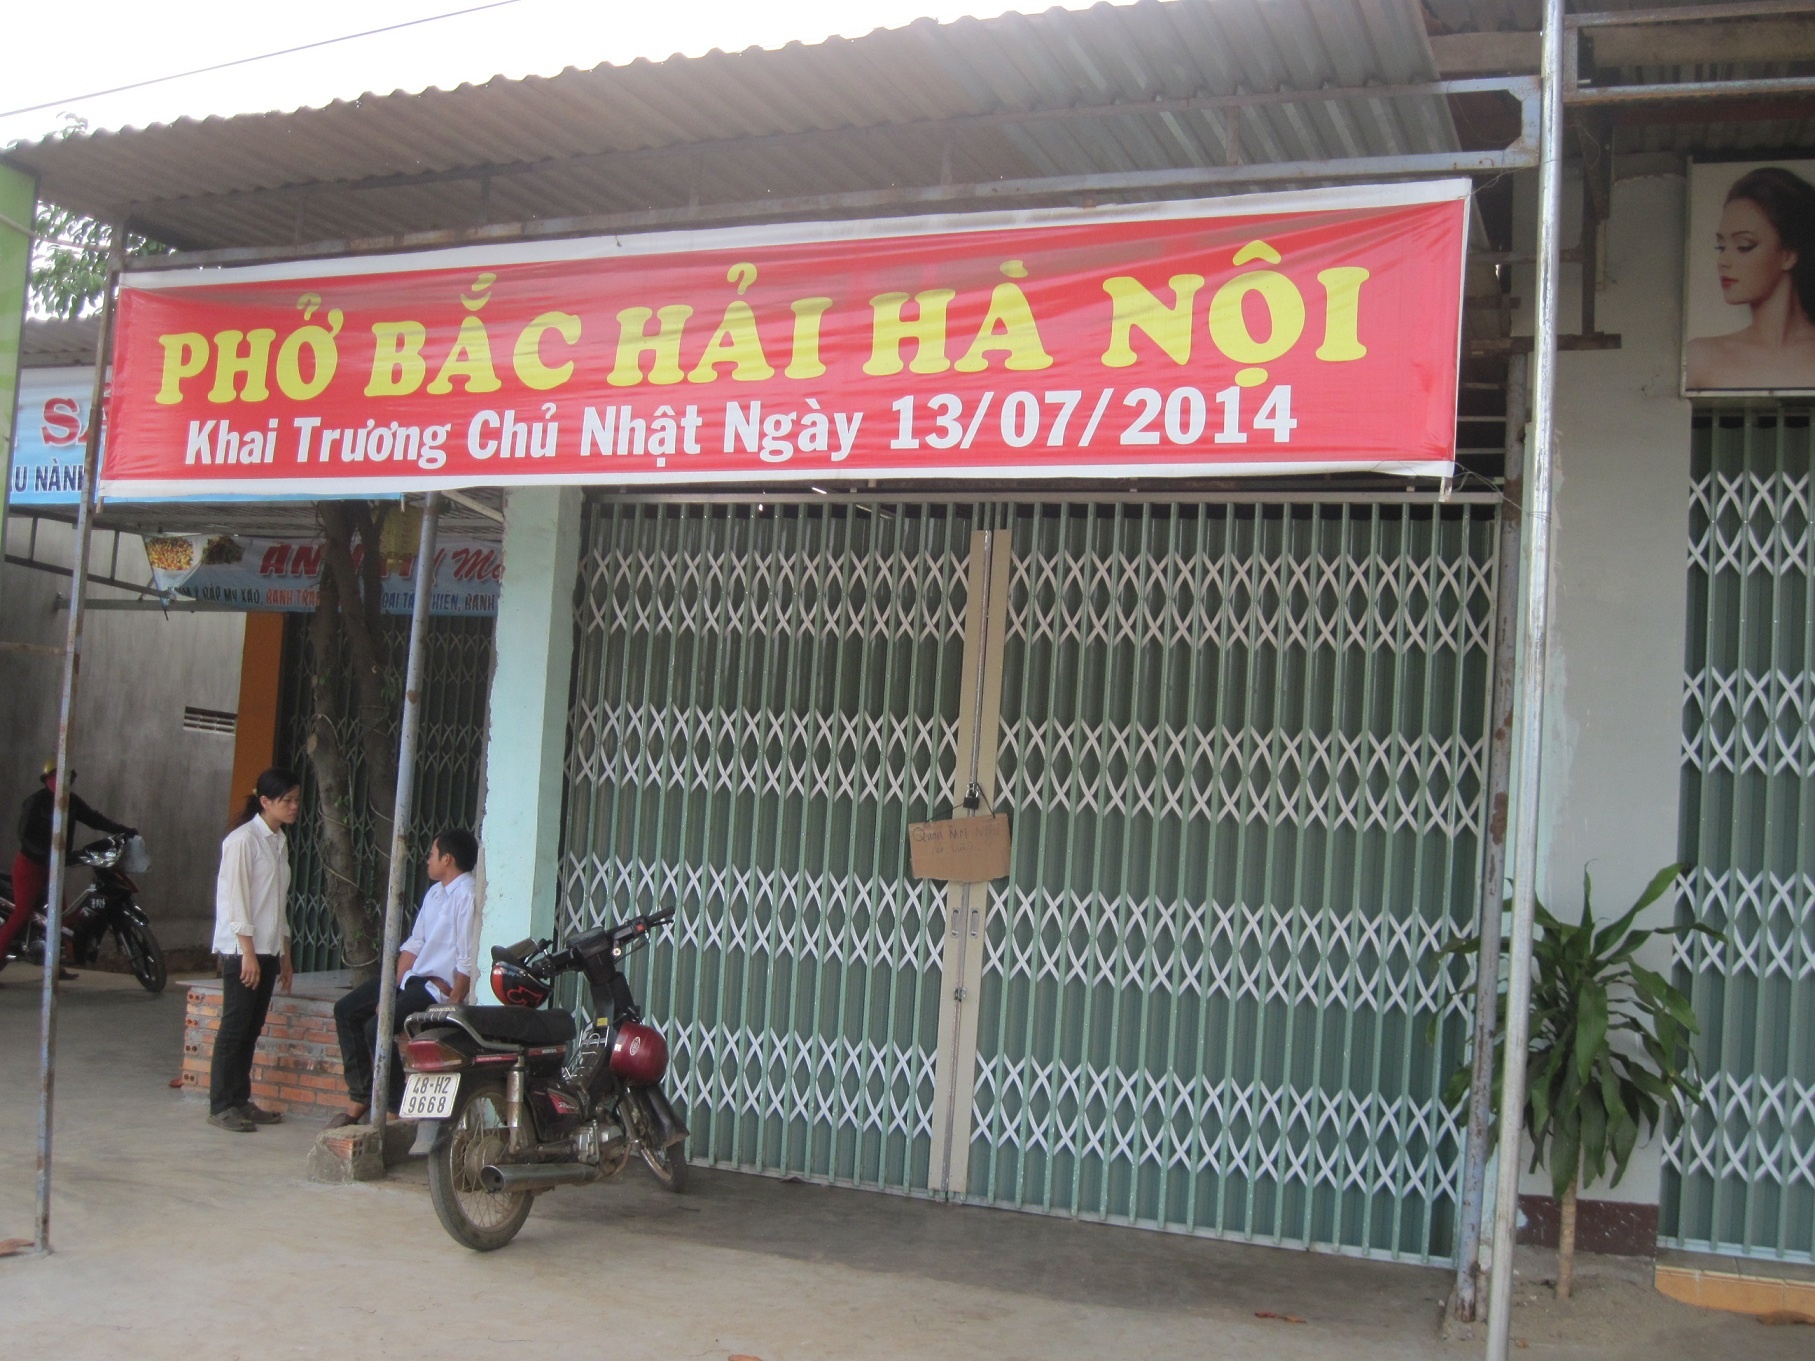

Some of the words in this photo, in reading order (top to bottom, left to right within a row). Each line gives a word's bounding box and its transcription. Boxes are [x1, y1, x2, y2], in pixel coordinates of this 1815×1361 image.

[155, 292, 344, 405] PHỞ
[364, 273, 582, 397] BẮC
[606, 262, 833, 387] HẢI
[862, 260, 1054, 377] HÀ
[1101, 239, 1370, 387] NỘI
[185, 418, 279, 465] Khai
[294, 416, 451, 470] Trương
[467, 402, 558, 460] Chủ
[580, 403, 703, 468] Nhật
[723, 398, 864, 462] Ngày
[407, 1096, 447, 1113] 9668
[412, 1076, 452, 1095] 48-H2
